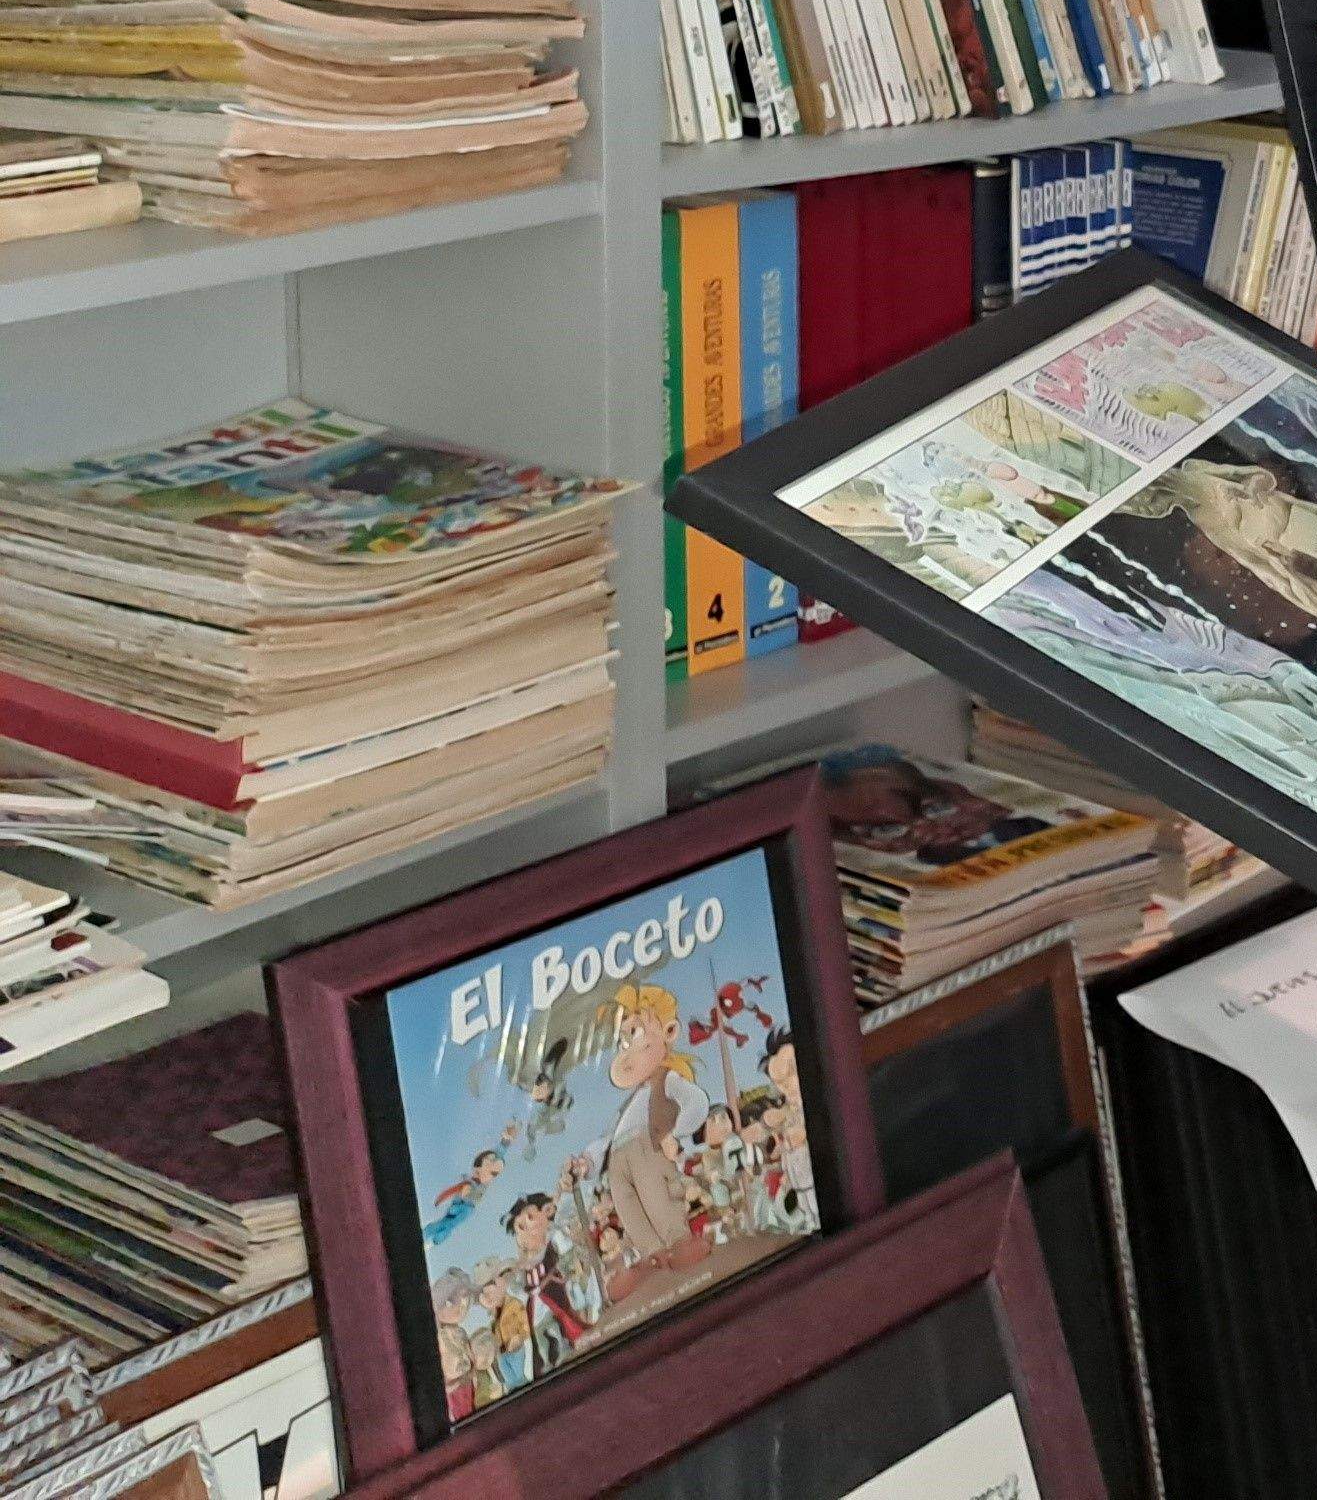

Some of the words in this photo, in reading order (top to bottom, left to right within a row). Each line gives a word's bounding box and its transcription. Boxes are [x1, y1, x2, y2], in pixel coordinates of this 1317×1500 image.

[707, 592, 725, 623] 4
[768, 576, 785, 609] 2
[450, 967, 506, 1046] El
[532, 893, 726, 1013] Boceto
